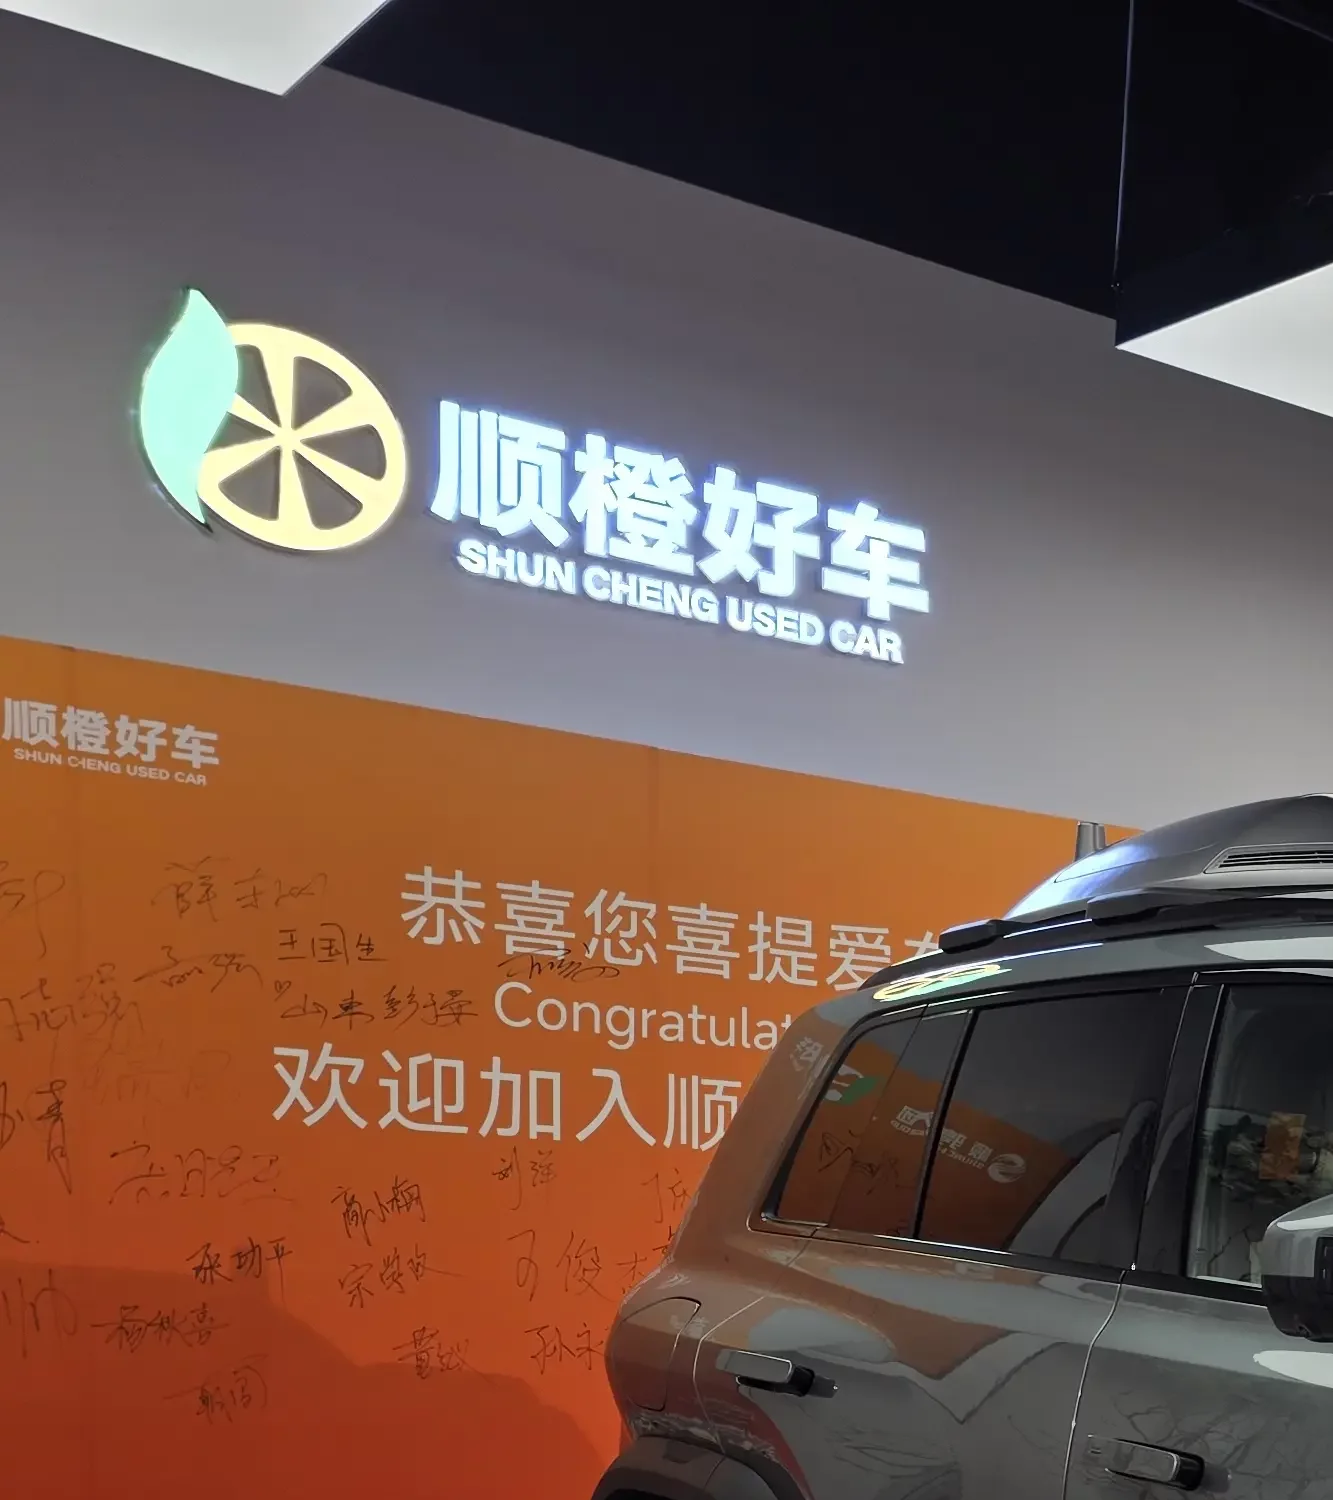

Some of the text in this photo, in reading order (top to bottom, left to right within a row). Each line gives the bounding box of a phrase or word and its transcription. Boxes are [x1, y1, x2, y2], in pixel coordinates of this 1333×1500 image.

[430, 400, 929, 620] 顺橙好车
[457, 539, 904, 664] SHUN CHENG USED CAR
[2, 697, 220, 769] 顺橙好车
[14, 748, 63, 765] SHUN
[126, 764, 170, 781] USED
[174, 771, 207, 786] CAR
